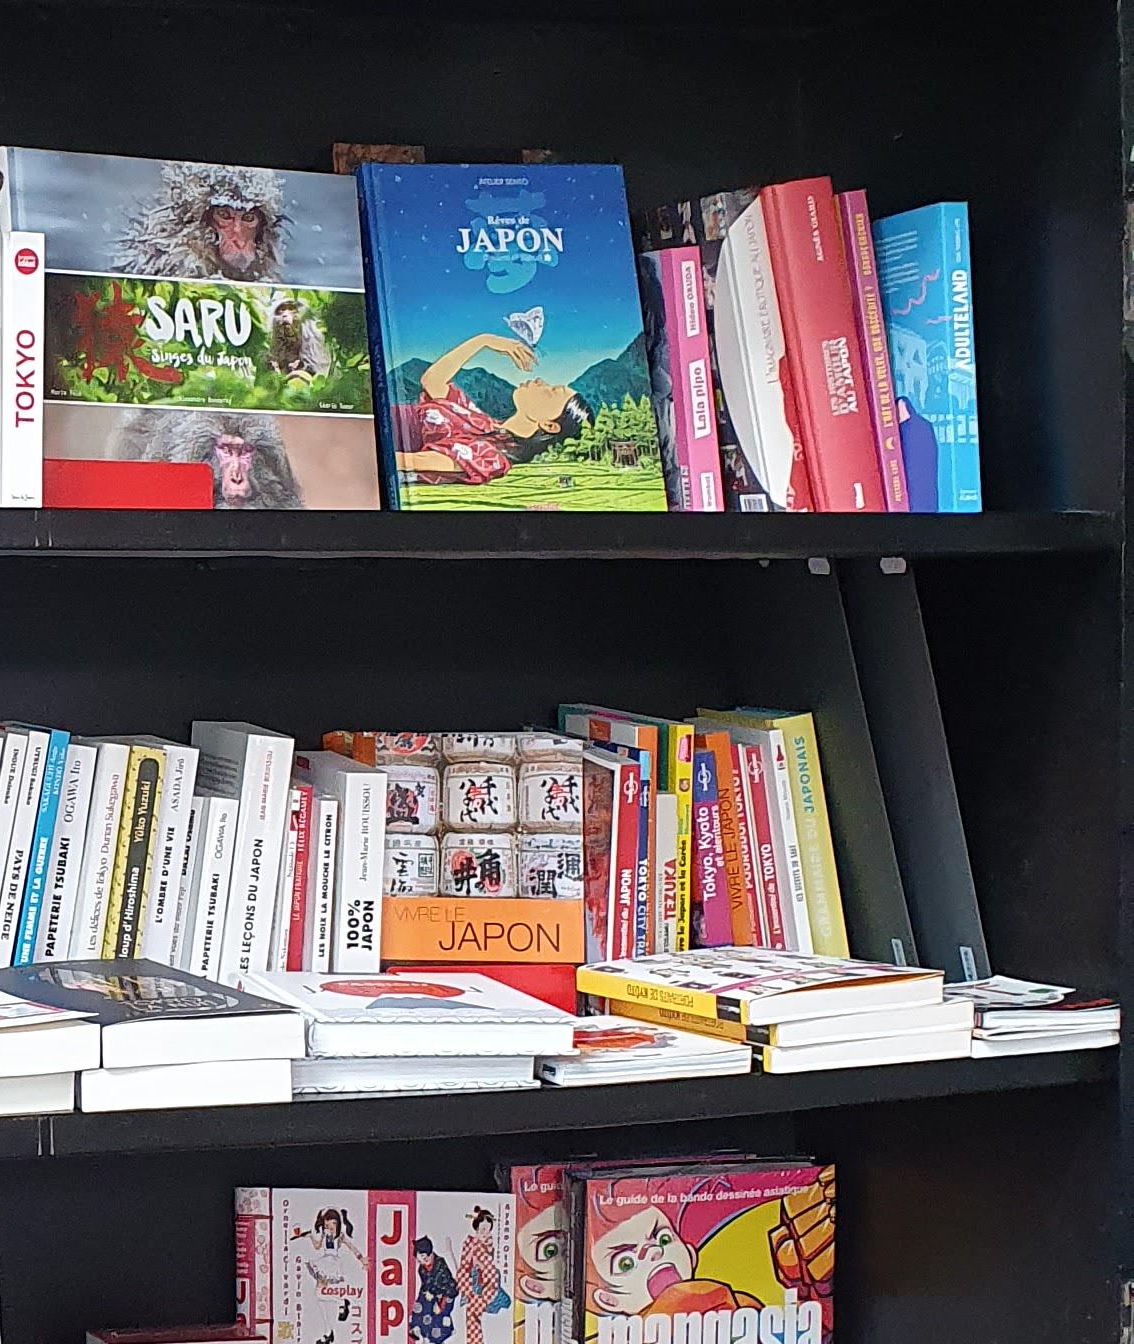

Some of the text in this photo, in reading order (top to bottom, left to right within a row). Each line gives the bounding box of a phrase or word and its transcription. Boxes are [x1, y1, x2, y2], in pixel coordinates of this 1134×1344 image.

[456, 227, 564, 254] JAPON
[146, 295, 252, 348] SARU
[952, 270, 970, 370] ADULTELAND
[15, 329, 36, 428] TOKYO
[795, 736, 815, 812] JAPONAIS
[324, 814, 332, 846] CITRON
[324, 850, 330, 858] LE
[698, 807, 717, 900] Tokyo, Kyoto
[721, 788, 743, 909] VIVRE LE JAPON
[45, 895, 62, 956] PAPETERIE
[54, 837, 70, 889] TSUBAKI
[63, 779, 79, 823] OGAWA
[155, 827, 175, 923] L'OMBRE D'UNE VIE
[620, 869, 631, 906] JAPON
[679, 870, 686, 879] la
[679, 881, 686, 891] et
[762, 844, 775, 881] TOKYO
[1, 849, 24, 940] PAYS DE NEIGE
[241, 839, 263, 953] LEÇONS DU JAPON
[320, 903, 327, 913] LA
[394, 907, 465, 922] VIVRE LE
[638, 859, 647, 936] TOKYO CITY
[664, 859, 676, 920] TEZUKA
[201, 874, 219, 971] PAPETERIE TSUBAKI
[347, 900, 360, 949] 100%
[363, 900, 374, 951] JAPON
[439, 922, 561, 953] JAPON
[599, 1184, 809, 1206] Le guide de la bande dessinée asiatique
[320, 1283, 364, 1299] cosplay
